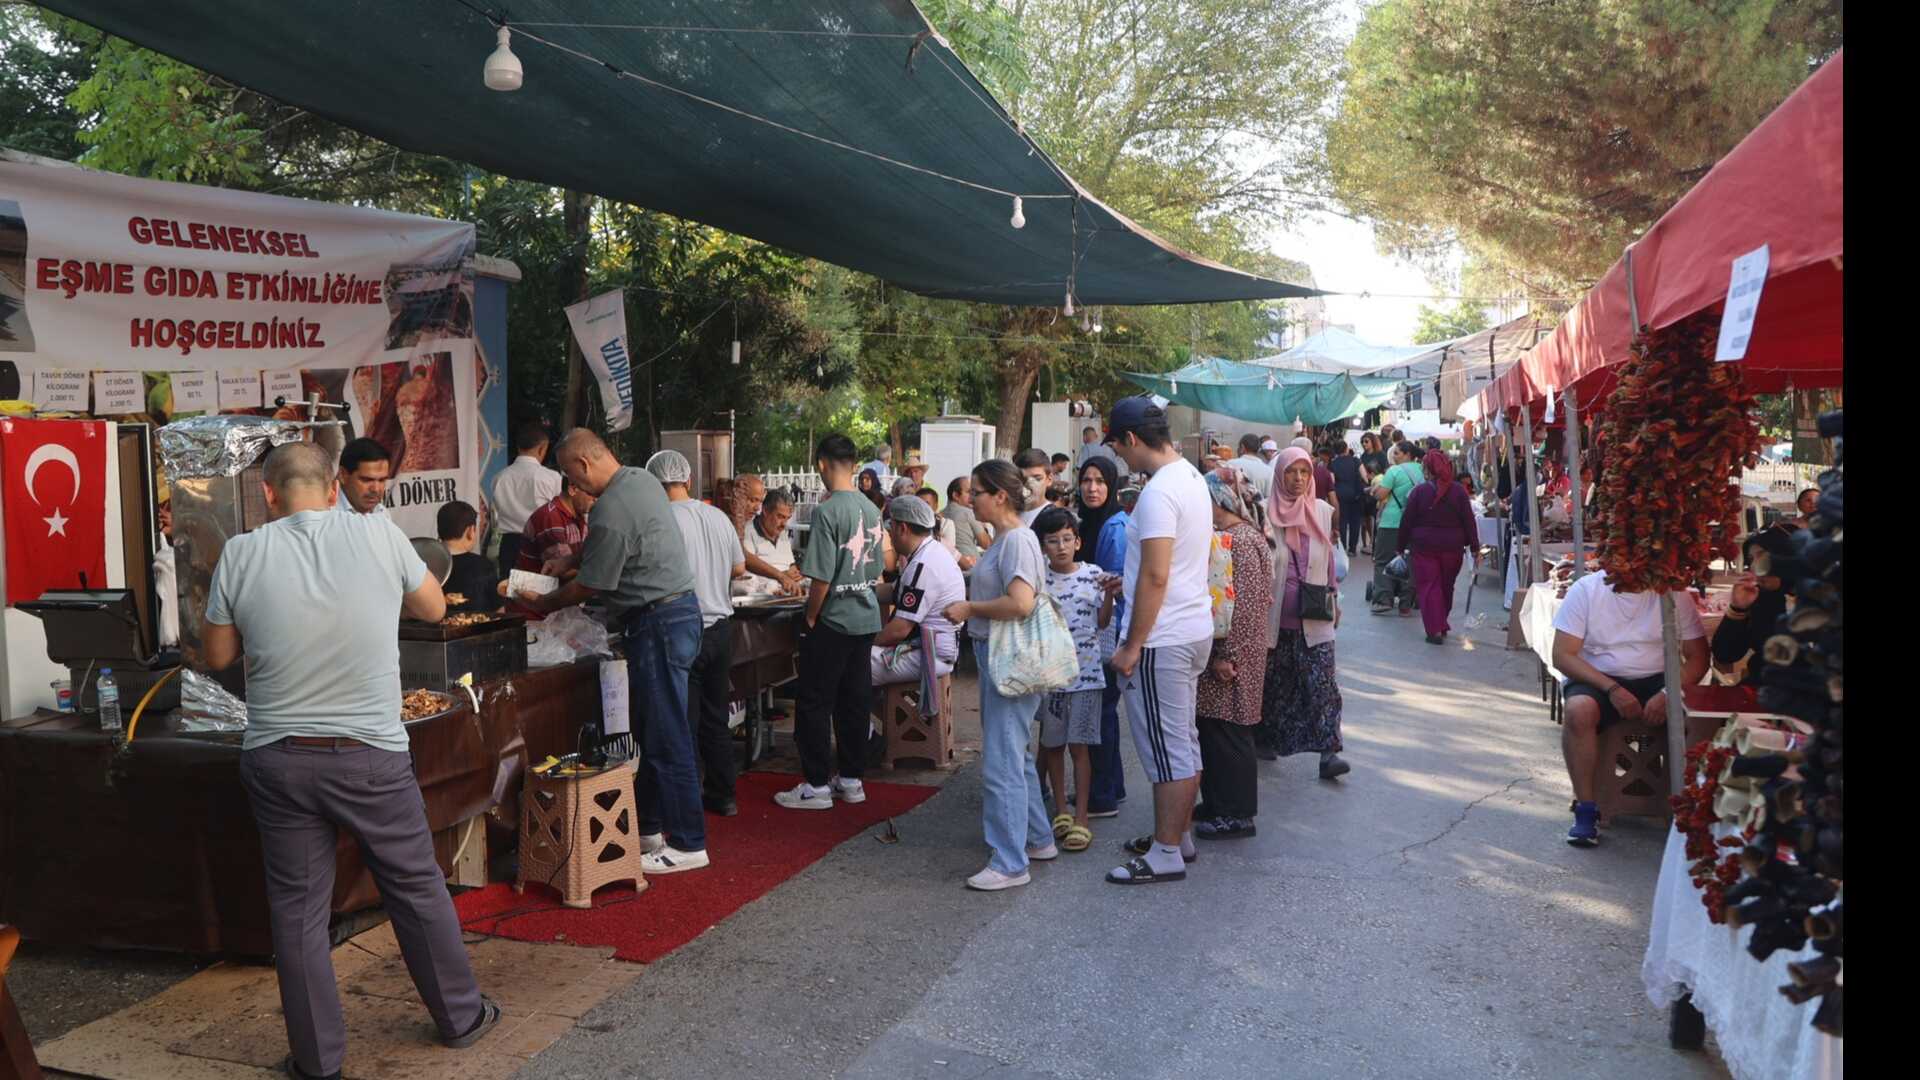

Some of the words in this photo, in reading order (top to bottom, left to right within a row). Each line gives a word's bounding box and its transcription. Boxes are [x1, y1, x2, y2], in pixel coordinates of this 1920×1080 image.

[128, 216, 320, 258] GELENEKSEL
[36, 257, 135, 299] EŞME
[143, 265, 219, 298] GIDA
[226, 269, 383, 304] ETKİNLİĞİNE
[130, 316, 325, 355] HOŞGELDİNİZ
[63, 371, 85, 379] DÖNER
[399, 476, 457, 507] DÖNER
